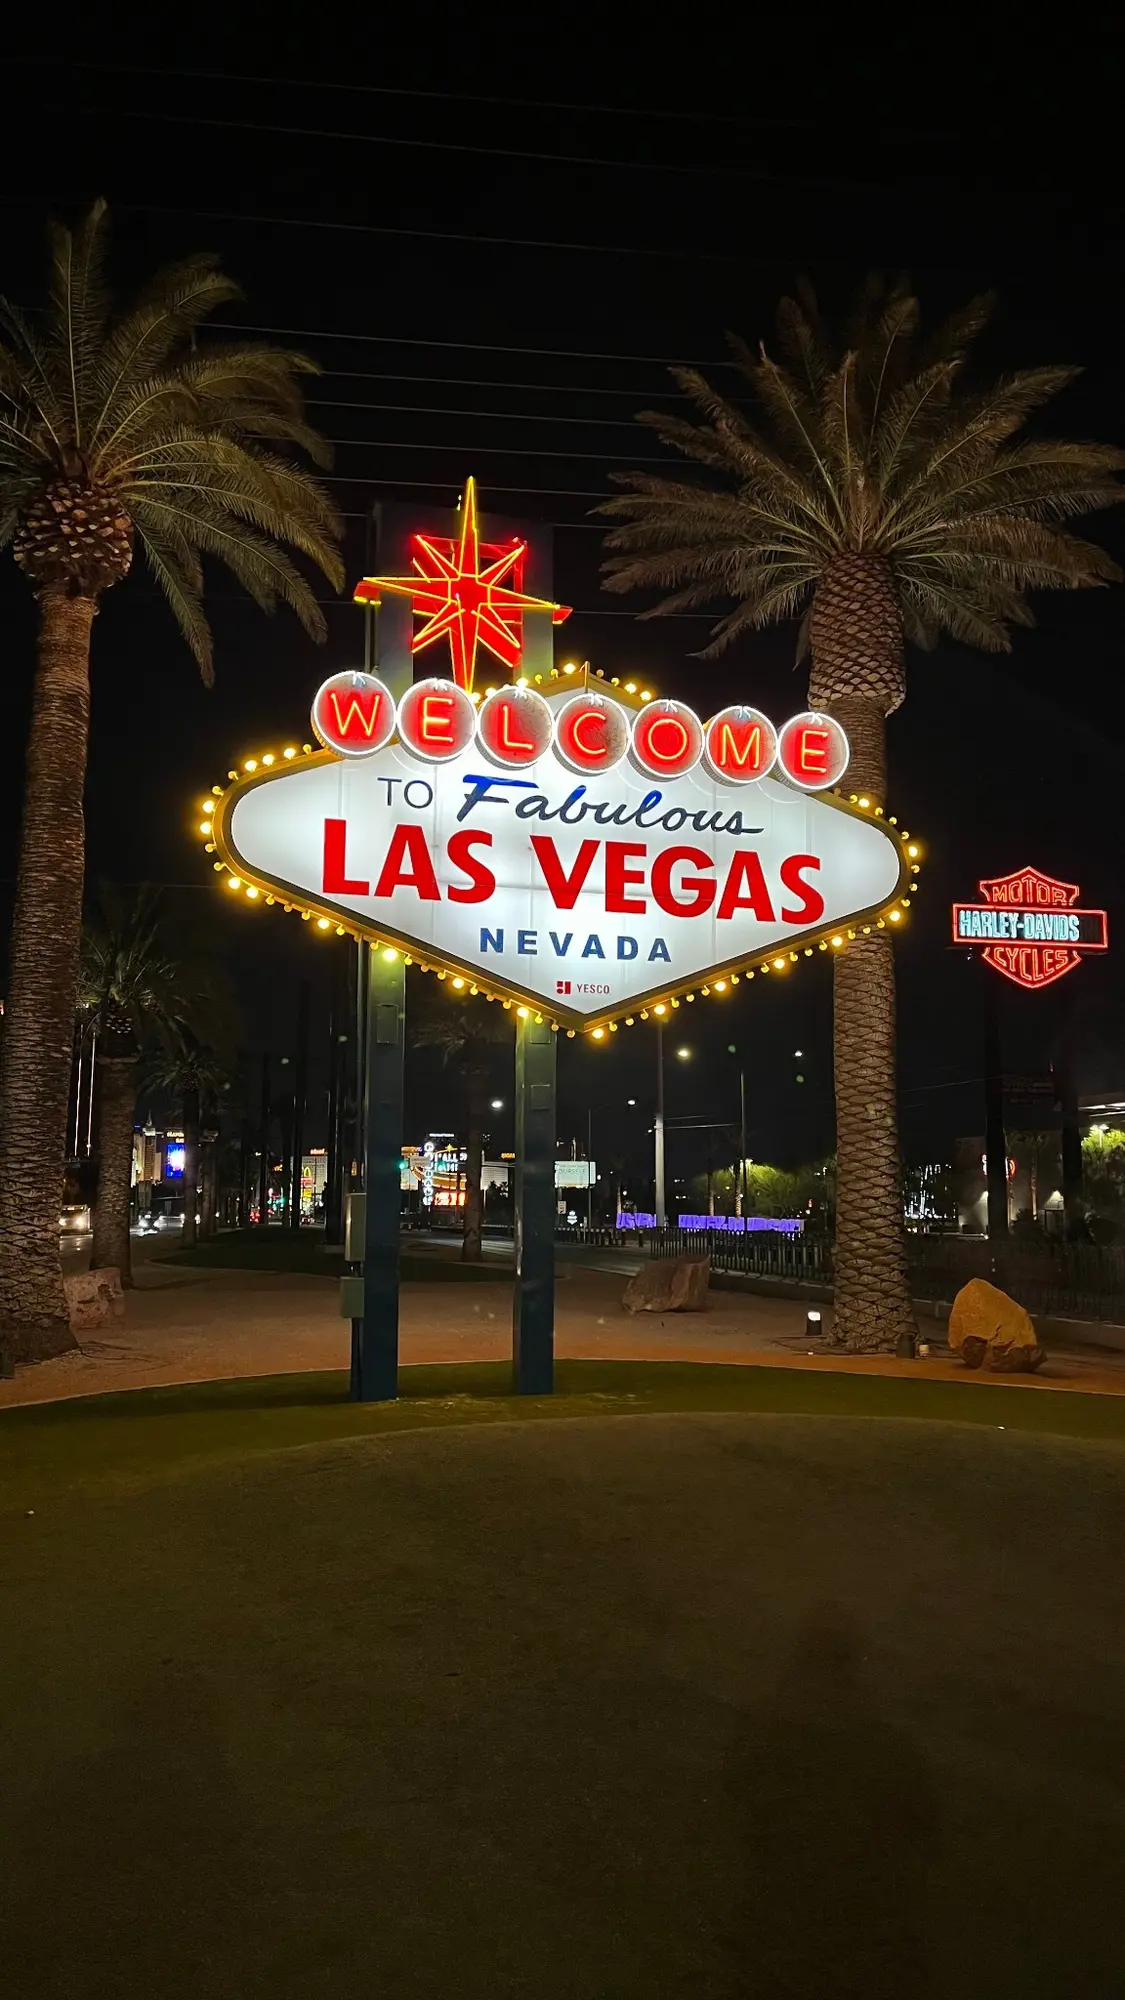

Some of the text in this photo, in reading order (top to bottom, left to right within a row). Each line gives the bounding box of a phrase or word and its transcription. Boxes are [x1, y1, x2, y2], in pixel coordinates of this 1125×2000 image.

[327, 691, 829, 774] WELCOME
[377, 774, 764, 836] TO Fabulous
[322, 818, 825, 925] LAS VEGAS
[993, 874, 1068, 905] MOTOR
[480, 928, 673, 963] NEVADA
[993, 947, 1069, 982] CYCLES
[576, 983, 610, 995] YESCO
